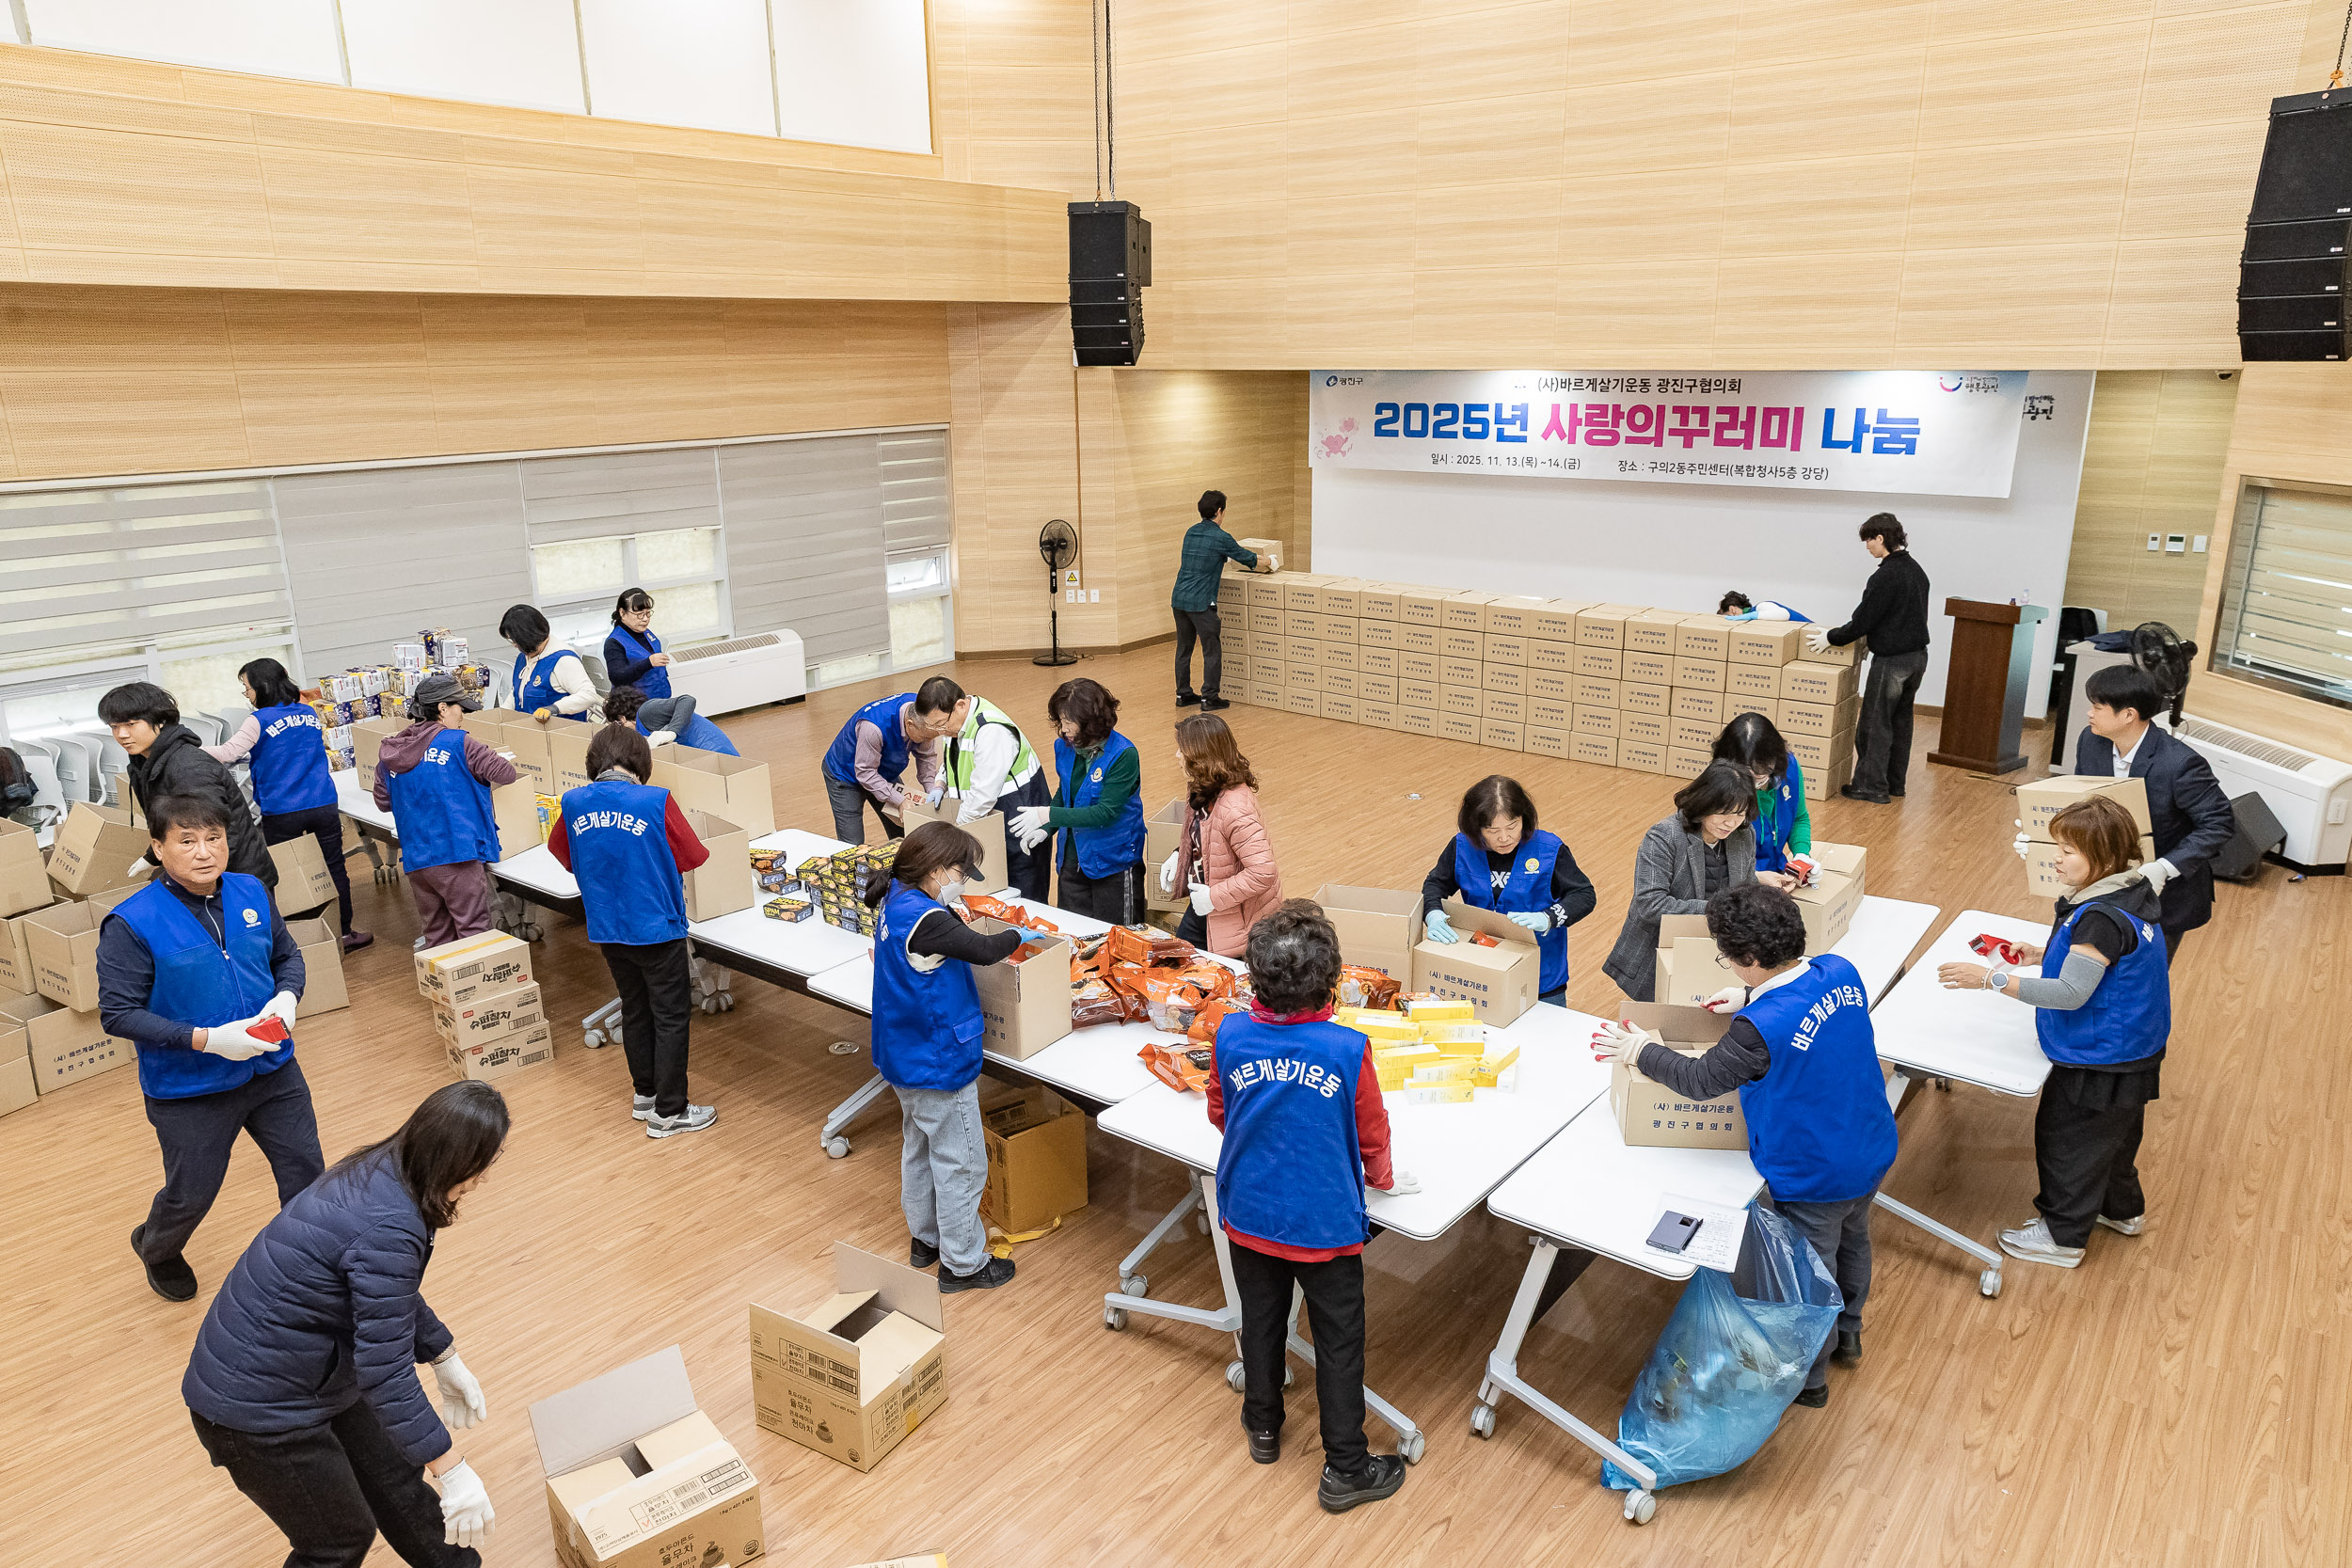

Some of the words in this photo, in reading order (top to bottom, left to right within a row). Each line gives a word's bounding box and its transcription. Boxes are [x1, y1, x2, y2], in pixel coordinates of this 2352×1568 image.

[1339, 376, 1363, 387] 광진구
[1537, 377, 1651, 394] (사)바르게살기운동
[1656, 378, 1741, 394] 광진구협의회
[1374, 403, 1529, 443] 2025년
[1540, 403, 1804, 451] 사랑의꾸러미
[1821, 407, 1921, 455] 나눔
[1430, 453, 1448, 466] 일시
[1456, 454, 1484, 467] 2025.
[1486, 456, 1502, 467] 11.
[1505, 456, 1537, 468] 13.(목)
[1617, 460, 1638, 472] 장소
[1647, 460, 1798, 480] 구의2동주민센터(복합청사5층
[1801, 466, 1829, 481] 강당)
[764, 906, 780, 915] SPAM
[1429, 970, 1441, 980] (사)
[1444, 974, 1488, 992] 바르게살기운동
[1790, 985, 1863, 1052] 바르게살기운동
[1229, 1058, 1342, 1099] 바르게살기운동
[1674, 1103, 1734, 1114] 바르게살기운동
[661, 1543, 693, 1566] 율무차
